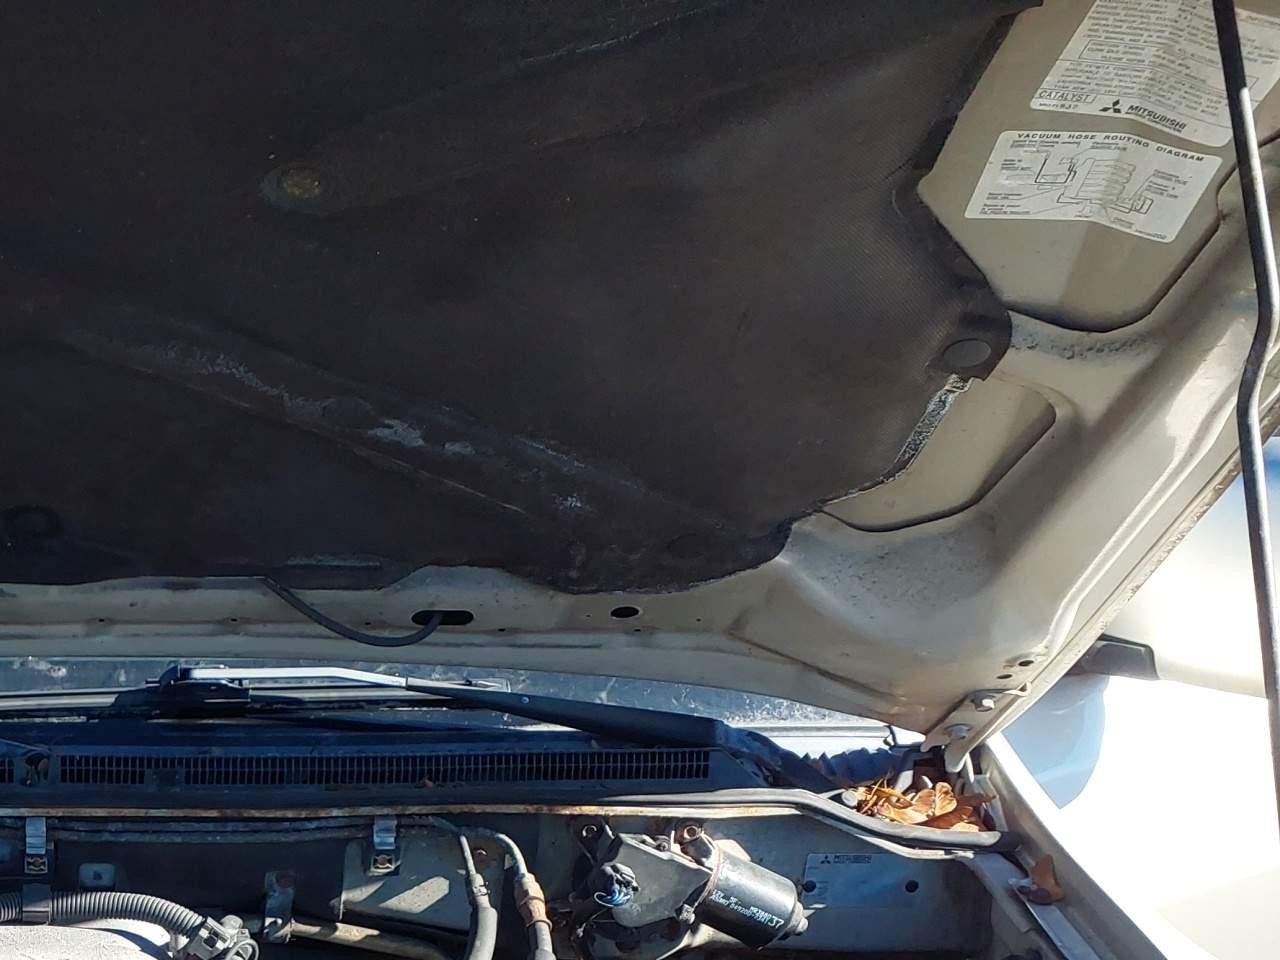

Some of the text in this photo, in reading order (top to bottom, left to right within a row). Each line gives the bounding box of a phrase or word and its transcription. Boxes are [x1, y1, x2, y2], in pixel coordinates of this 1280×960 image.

[1039, 90, 1090, 101] CATALYST
[1127, 104, 1187, 130] MITSUBISHI
[1103, 134, 1150, 148] ROUTING
[1155, 145, 1205, 162] DIAGRAM
